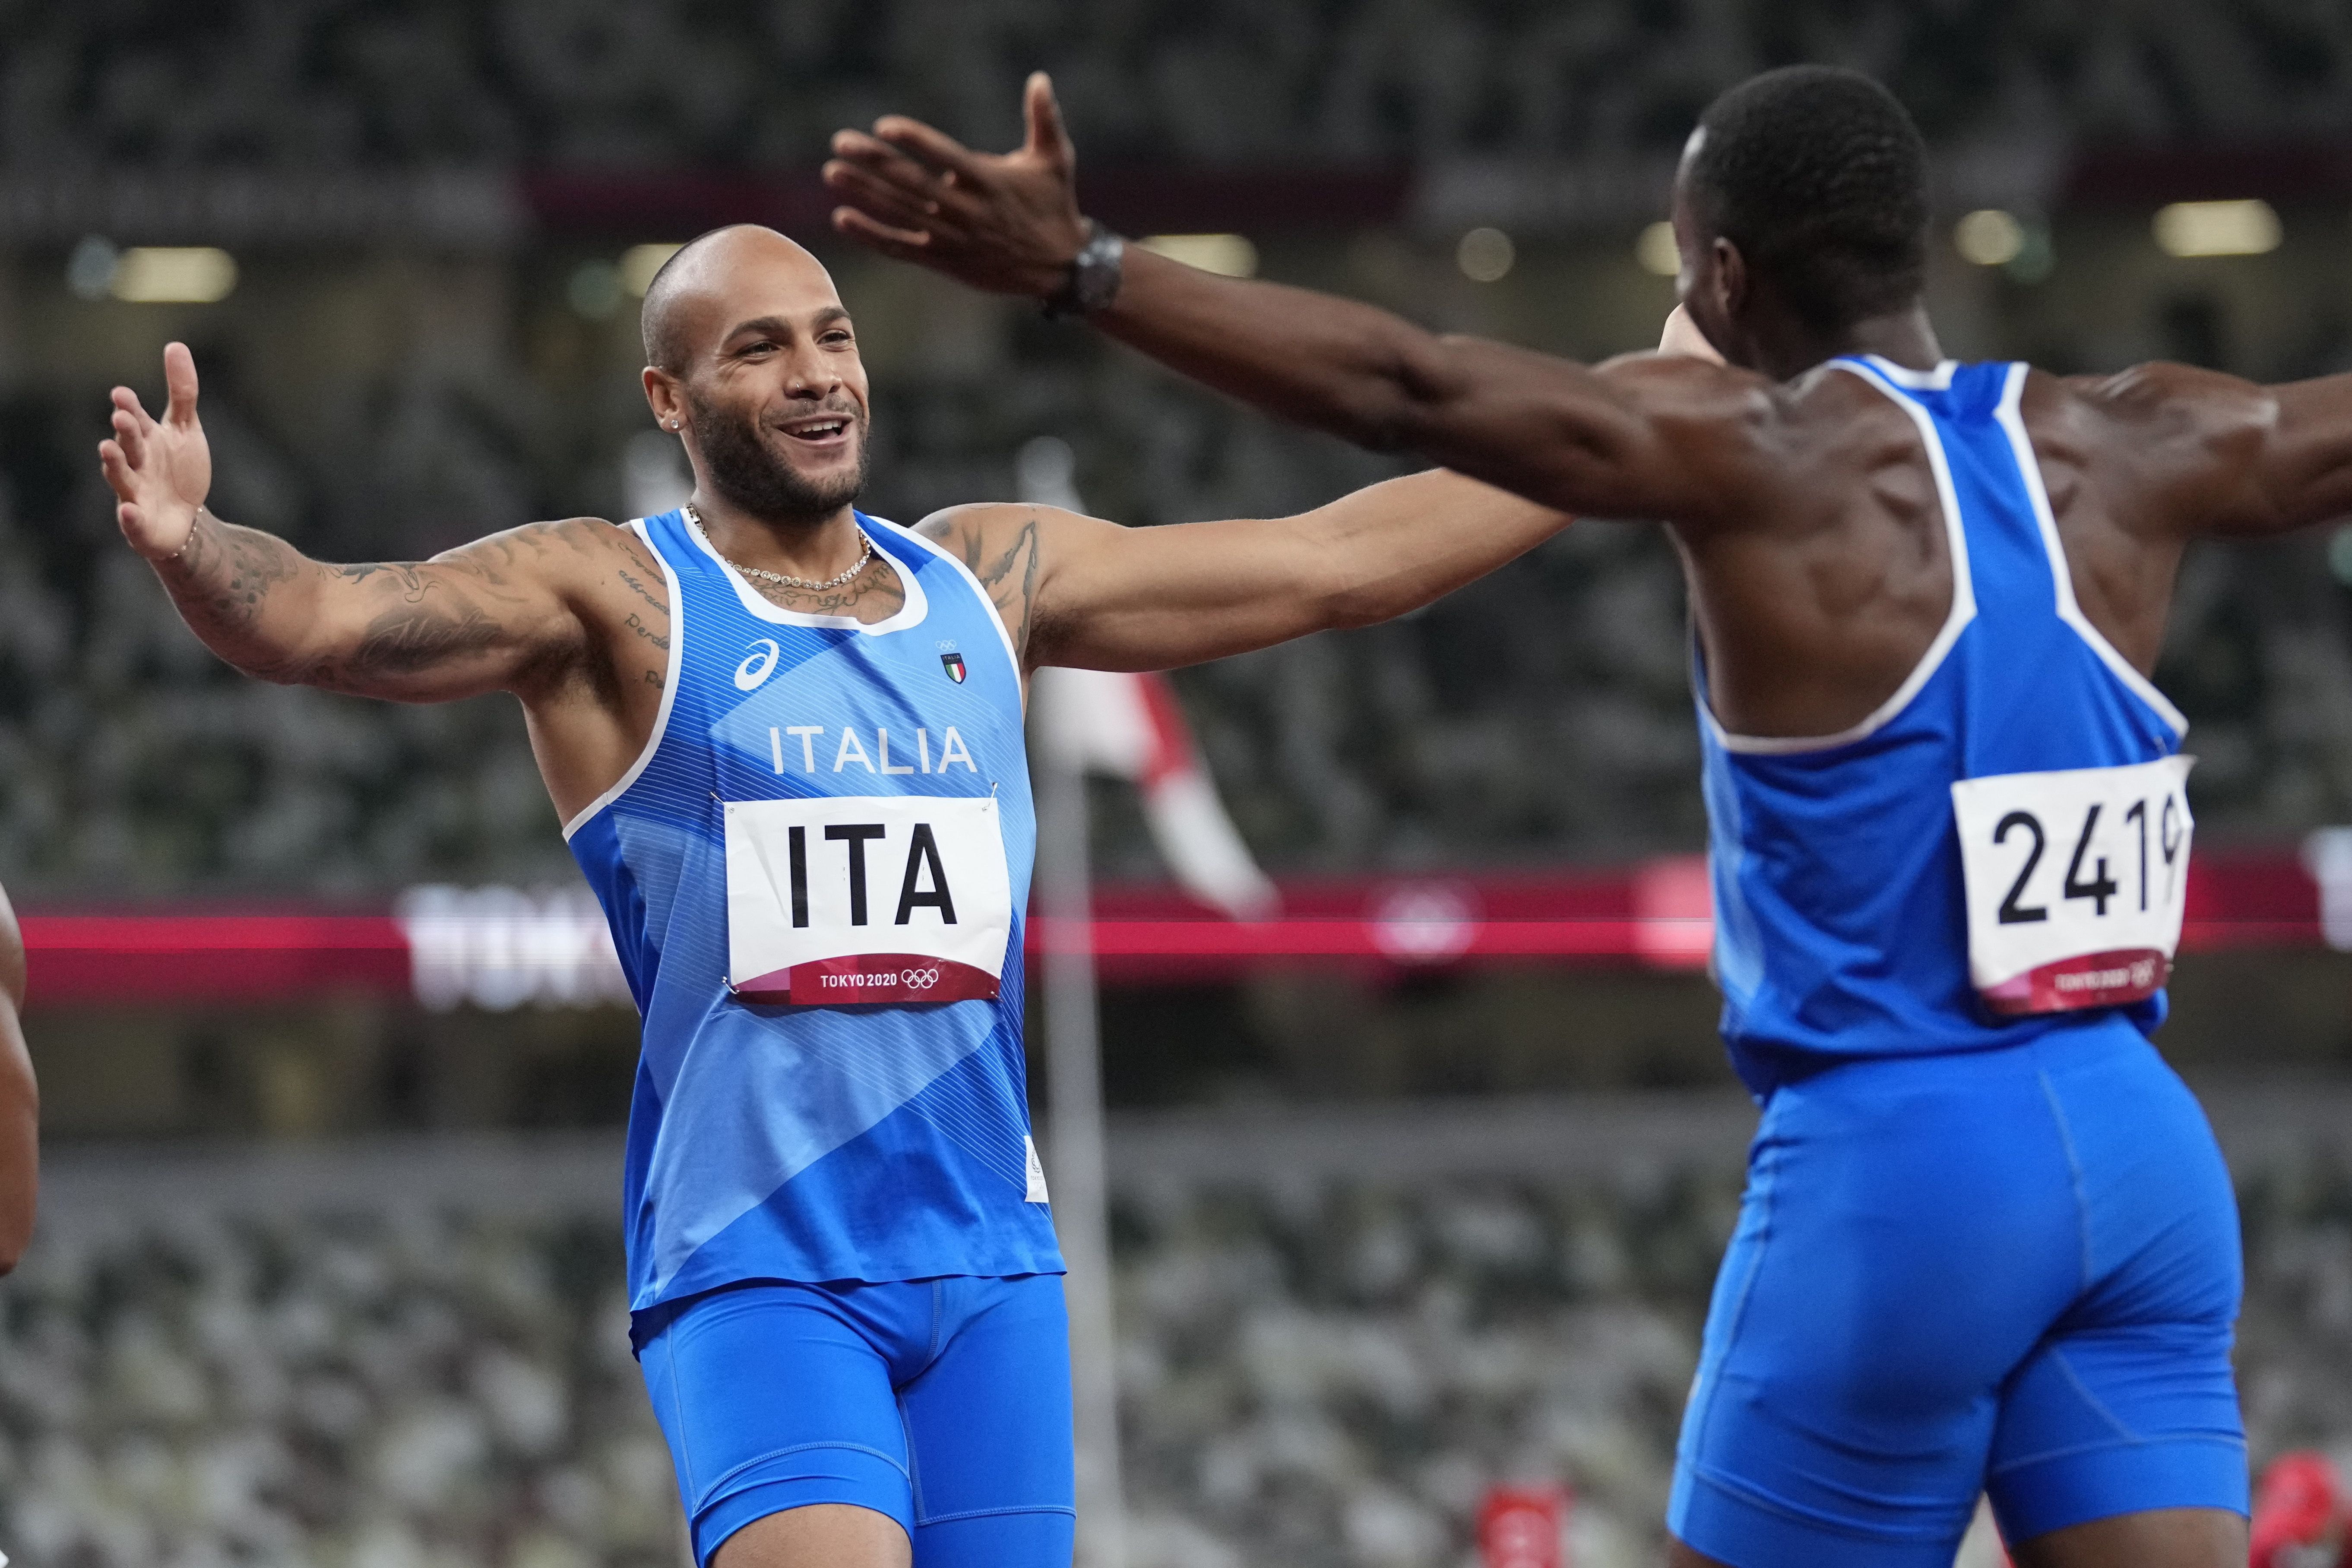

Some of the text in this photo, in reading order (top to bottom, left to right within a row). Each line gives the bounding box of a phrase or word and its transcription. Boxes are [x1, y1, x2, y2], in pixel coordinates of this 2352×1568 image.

[769, 725, 978, 775] ITALIA
[788, 823, 958, 928] ITA
[820, 973, 897, 988] TOKYO 2020
